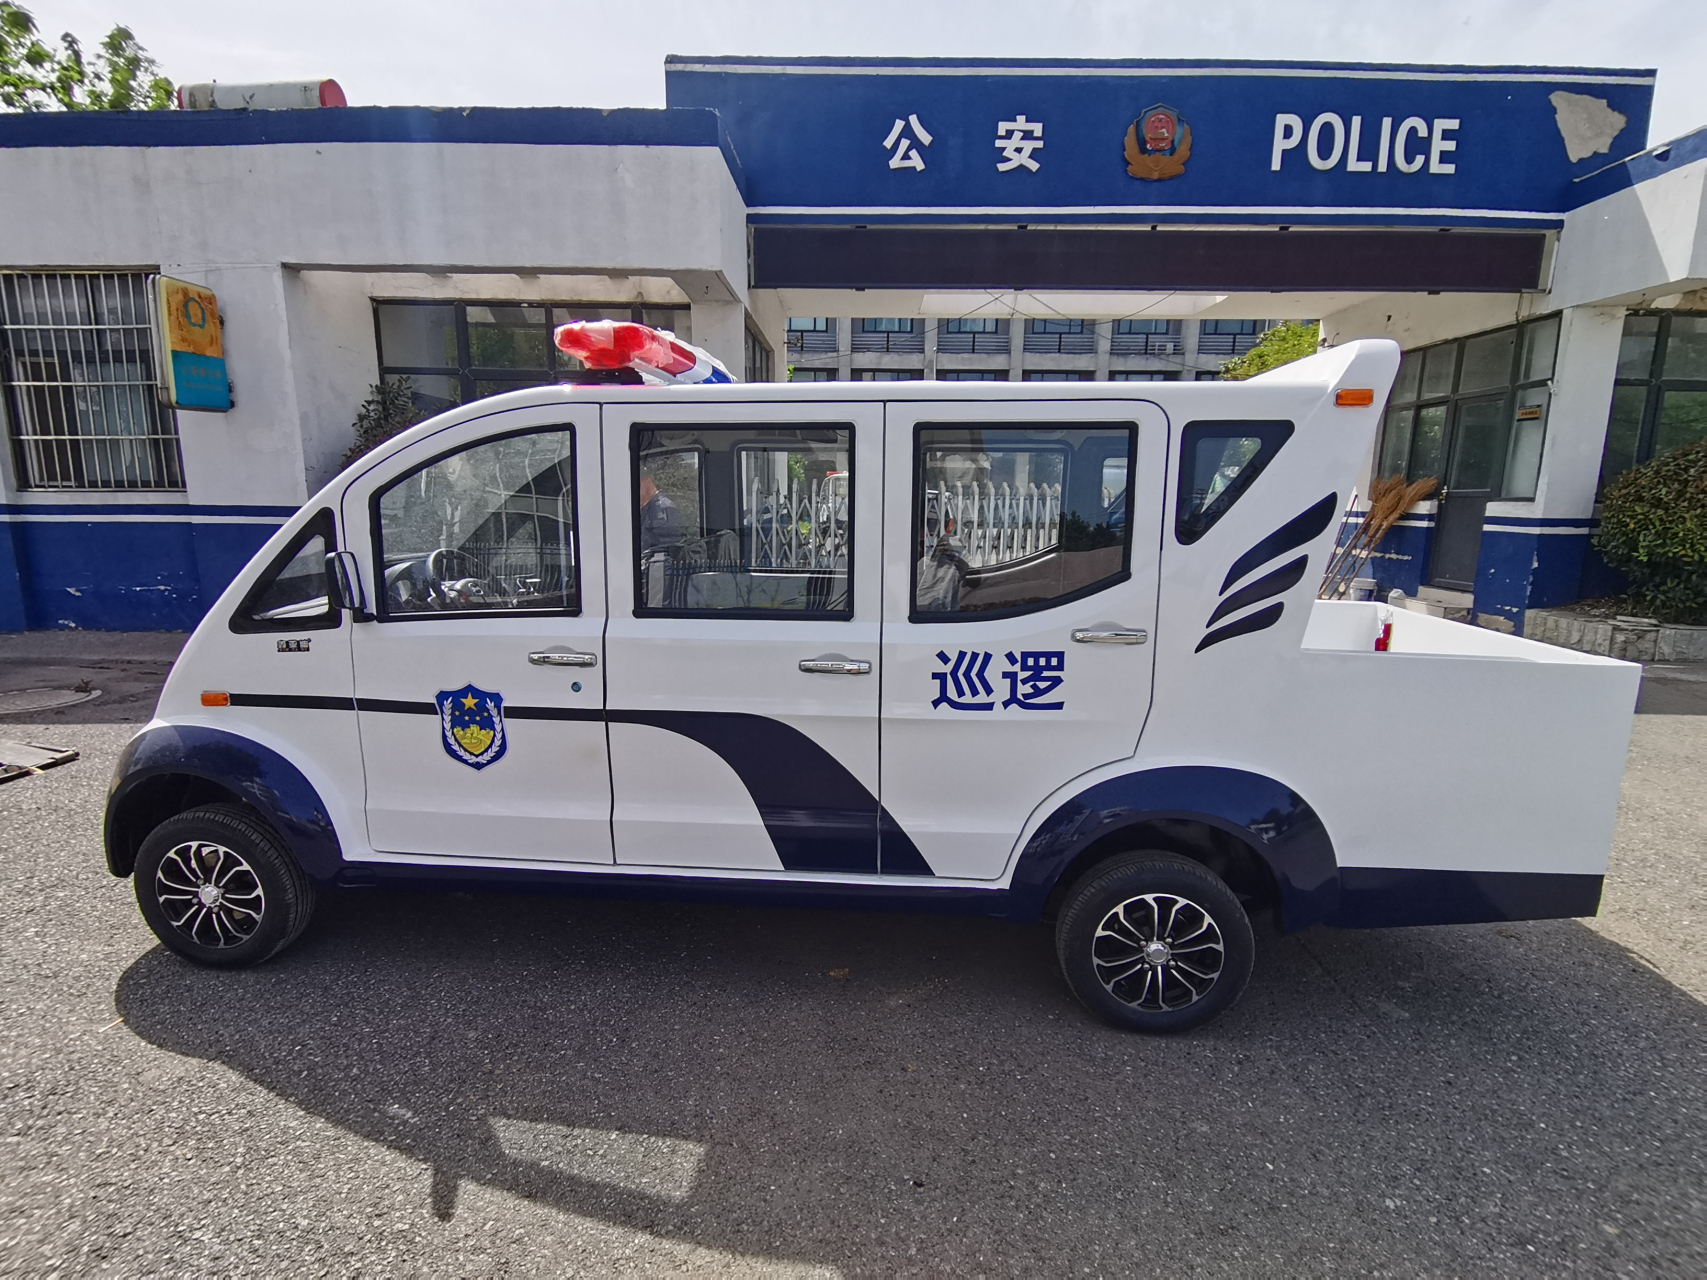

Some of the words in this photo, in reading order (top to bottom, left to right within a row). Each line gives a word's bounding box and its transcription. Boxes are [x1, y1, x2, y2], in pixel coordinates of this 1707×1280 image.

[882, 113, 1044, 173] 公安
[1270, 111, 1461, 174] POLICE
[931, 650, 1065, 711] 巡逻
